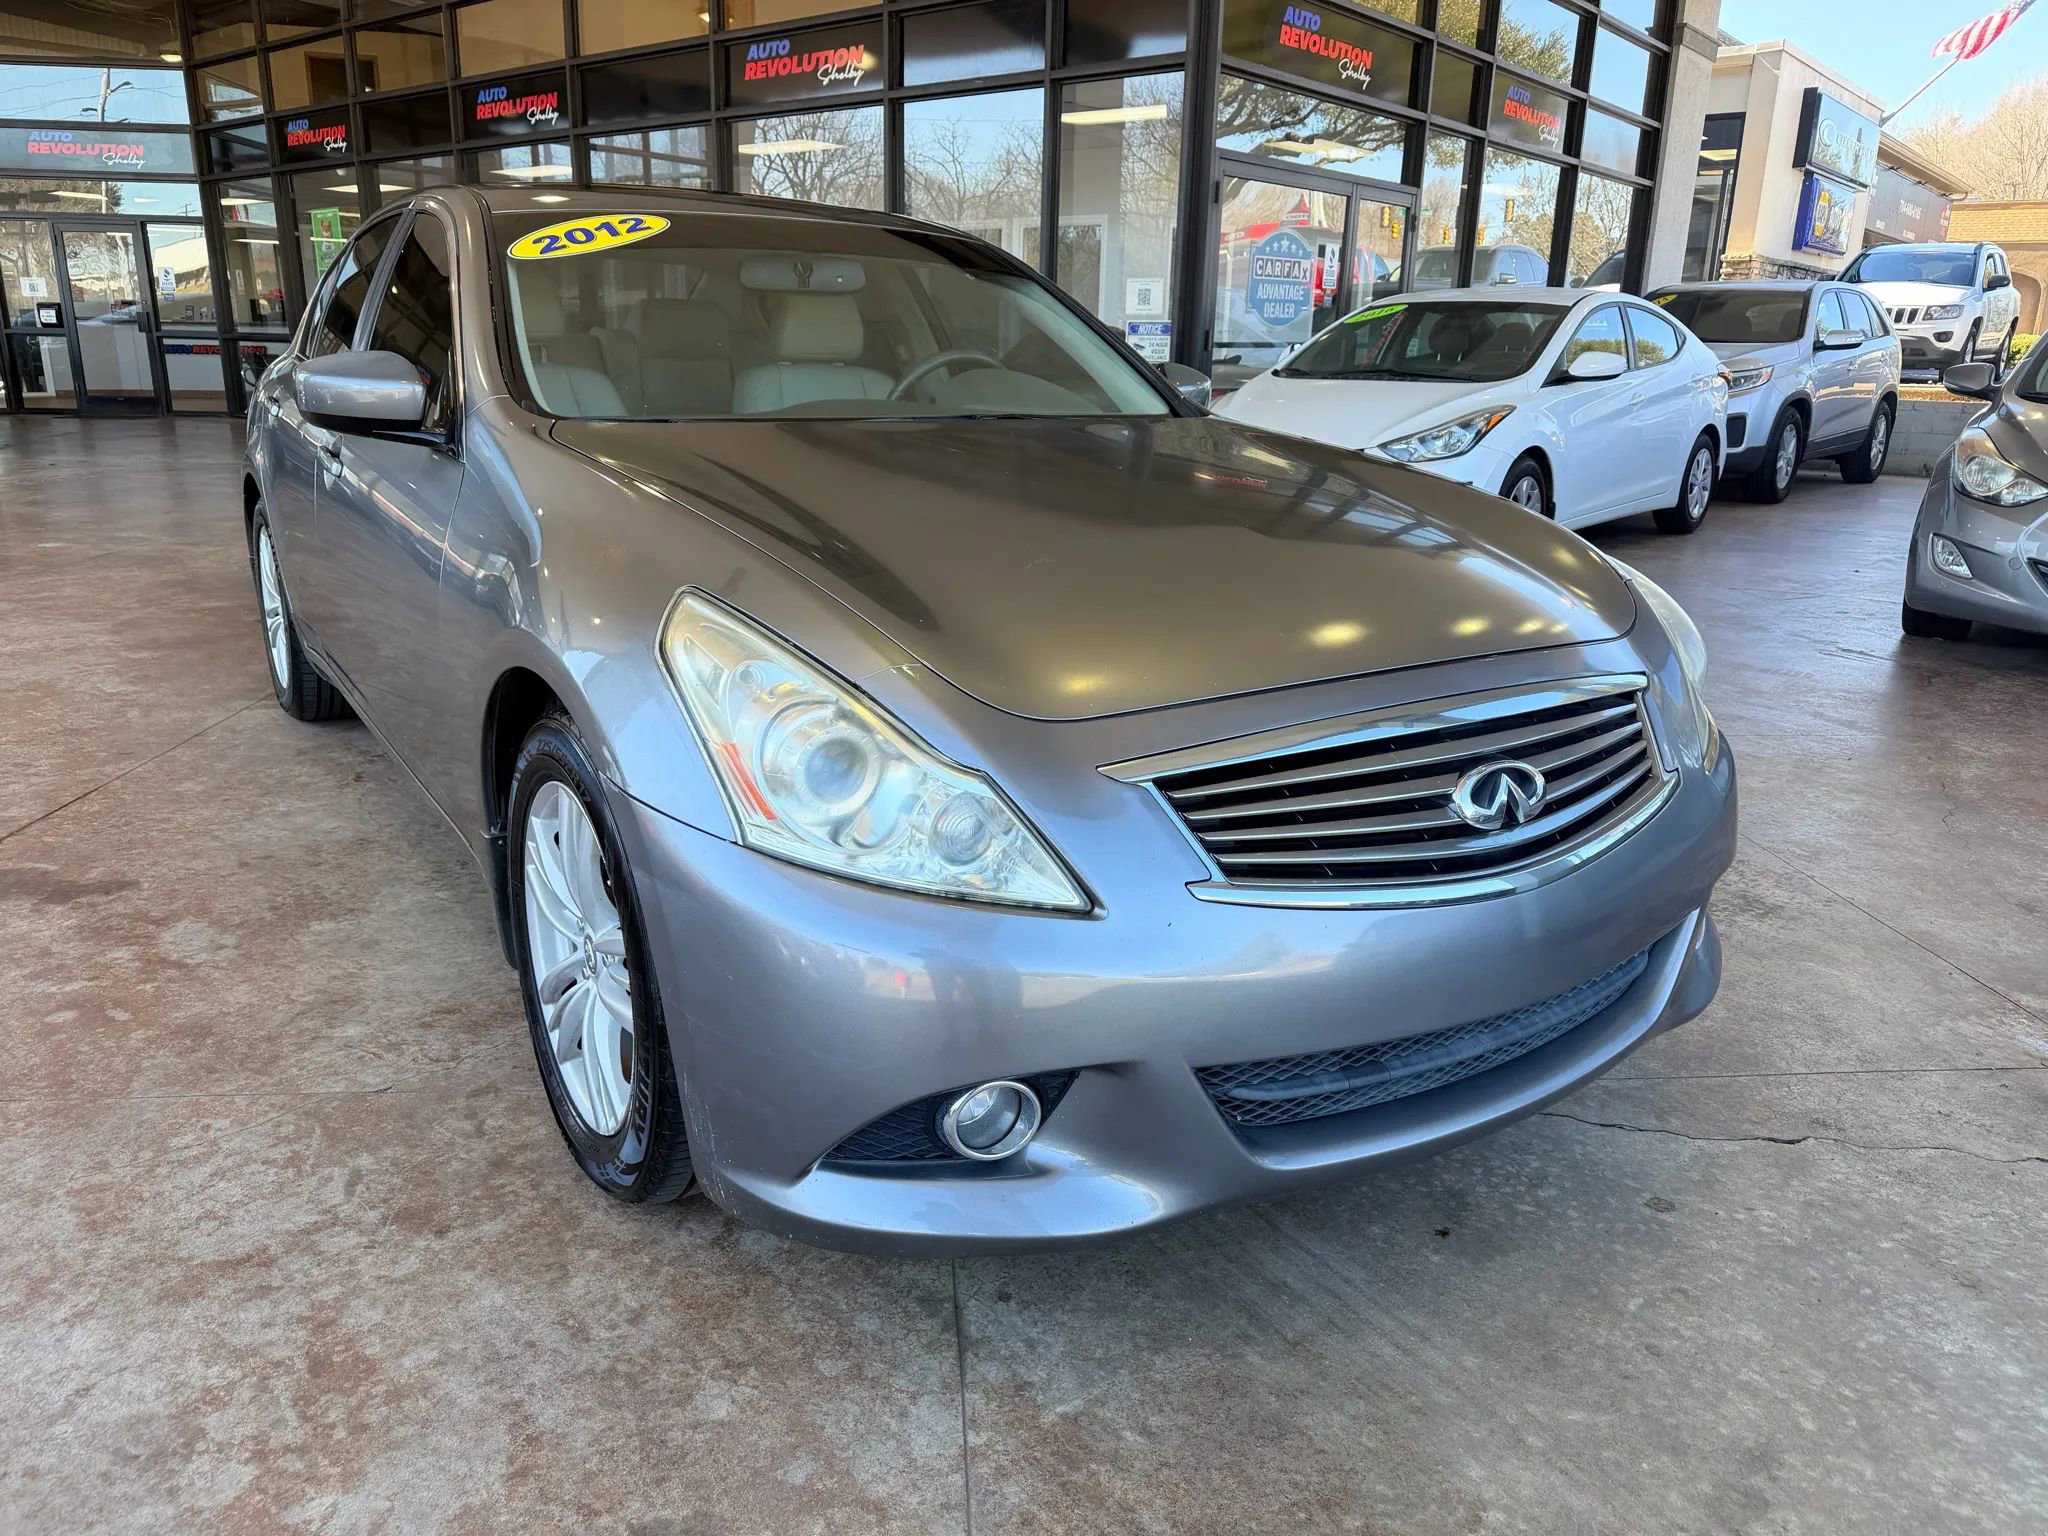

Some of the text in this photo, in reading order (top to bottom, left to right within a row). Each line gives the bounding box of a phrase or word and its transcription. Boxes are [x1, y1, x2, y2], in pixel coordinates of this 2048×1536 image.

[1283, 5, 1321, 31] AUTO
[747, 38, 791, 60] AUTO
[1279, 24, 1373, 69] REVOLUTION
[744, 44, 864, 80] REVOLUTION
[817, 58, 864, 86] Shelby
[1338, 58, 1371, 90] Shelby
[476, 91, 558, 120] REVOLUTION
[477, 86, 507, 103] AUTO
[1506, 85, 1531, 104] AUTO
[288, 118, 309, 132] AUTO
[526, 103, 559, 126] Shelby
[1503, 98, 1561, 129] REVOLUTION
[28, 131, 73, 142] AUTO
[287, 124, 346, 147] REVOLUTION
[323, 135, 347, 153] Shelby
[1538, 124, 1559, 149] Shelby
[27, 142, 144, 157] REVOLUTION
[102, 152, 146, 169] Shelby
[532, 216, 655, 255] 2012
[1255, 257, 1309, 281] CARFAX
[1257, 282, 1305, 300] ADVANTAGE
[1263, 302, 1295, 318] DEALER
[1137, 323, 1163, 335] NOTICE
